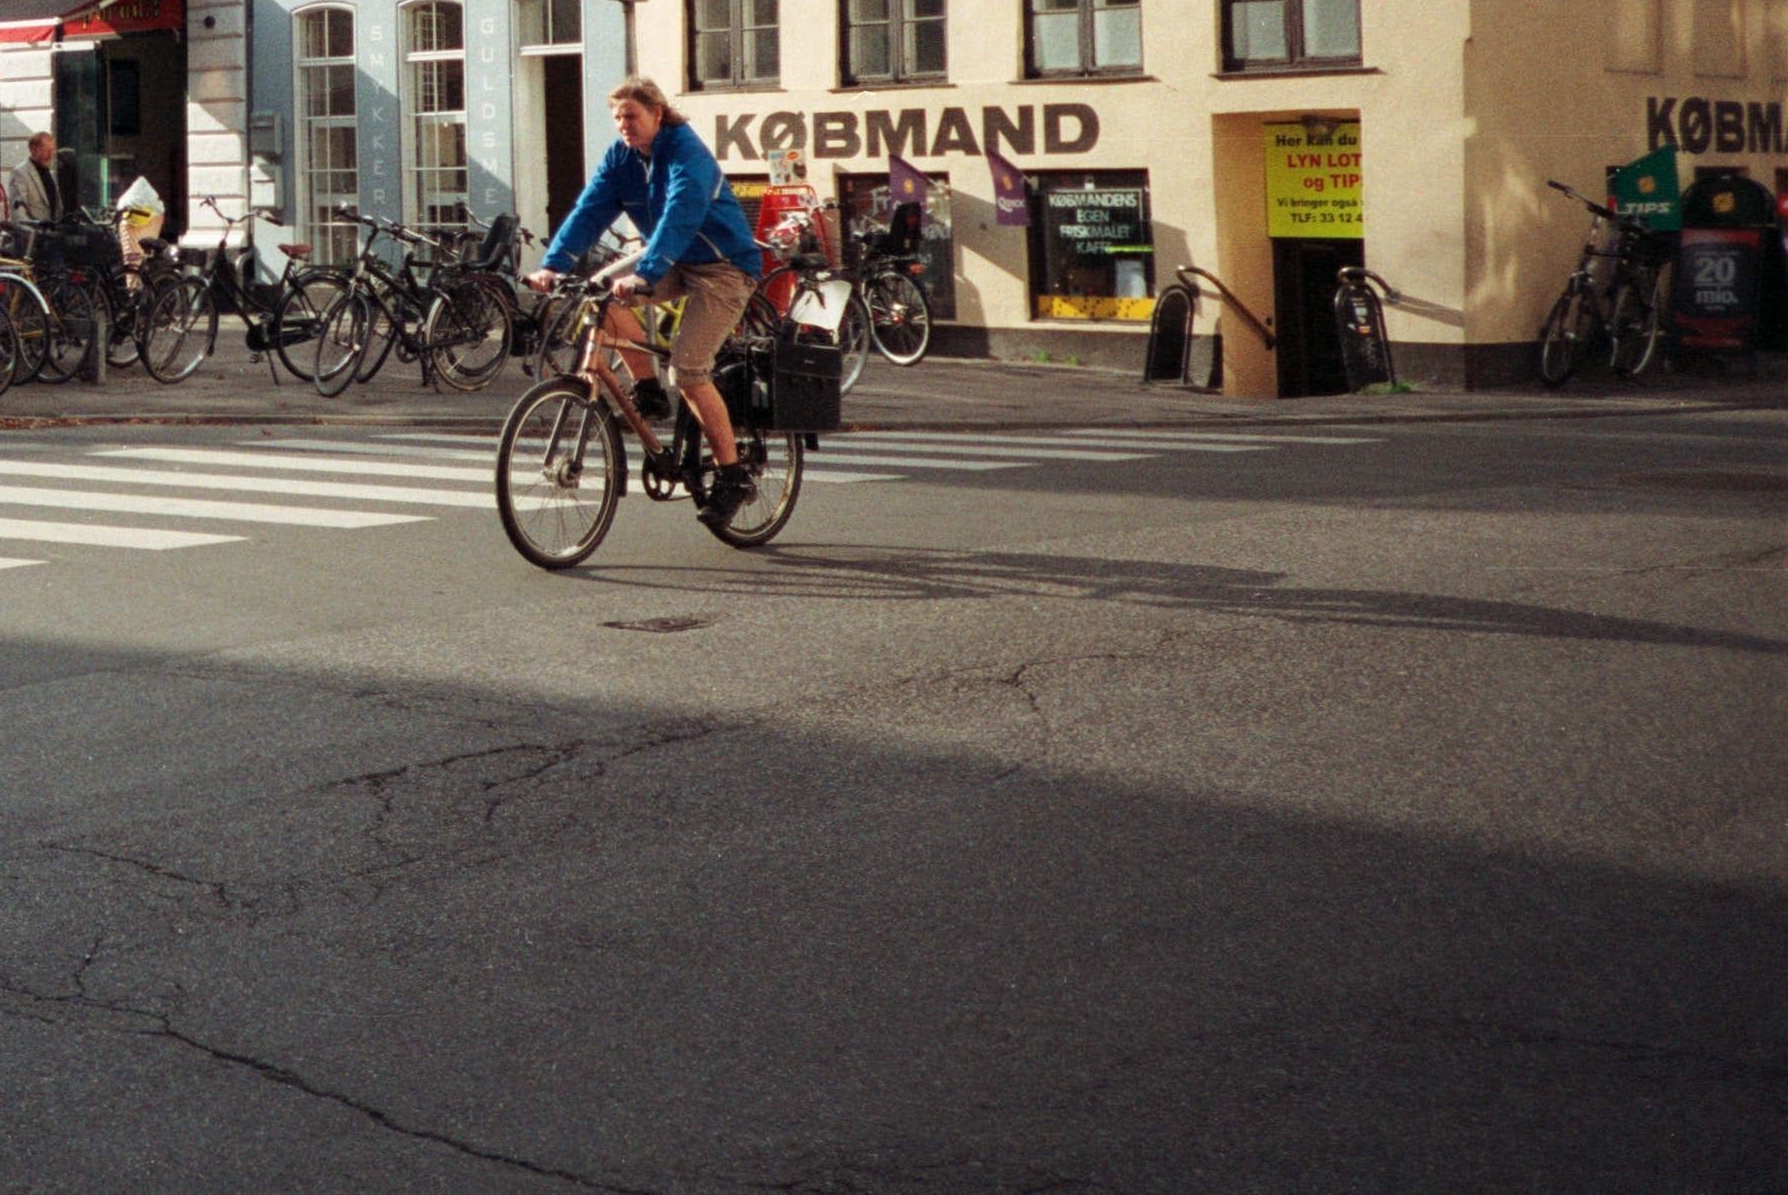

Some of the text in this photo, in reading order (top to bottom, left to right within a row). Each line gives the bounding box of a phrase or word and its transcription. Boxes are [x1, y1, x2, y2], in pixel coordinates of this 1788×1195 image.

[715, 102, 1100, 162] KØBMAND
[1647, 96, 1788, 155] KØBM
[1275, 132, 1357, 147] Her kan du
[1287, 153, 1322, 169] LYN
[1303, 173, 1363, 193] og TIP
[1048, 193, 1138, 208] KØBMANDENS
[1277, 197, 1358, 210] Vi bringer også
[1076, 209, 1110, 223] EGEN
[1291, 212, 1317, 223] TLF:
[1320, 212, 1335, 223] 33
[1339, 212, 1353, 223] 12
[1059, 225, 1131, 239] FRISKMALET
[1694, 257, 1736, 283] 20
